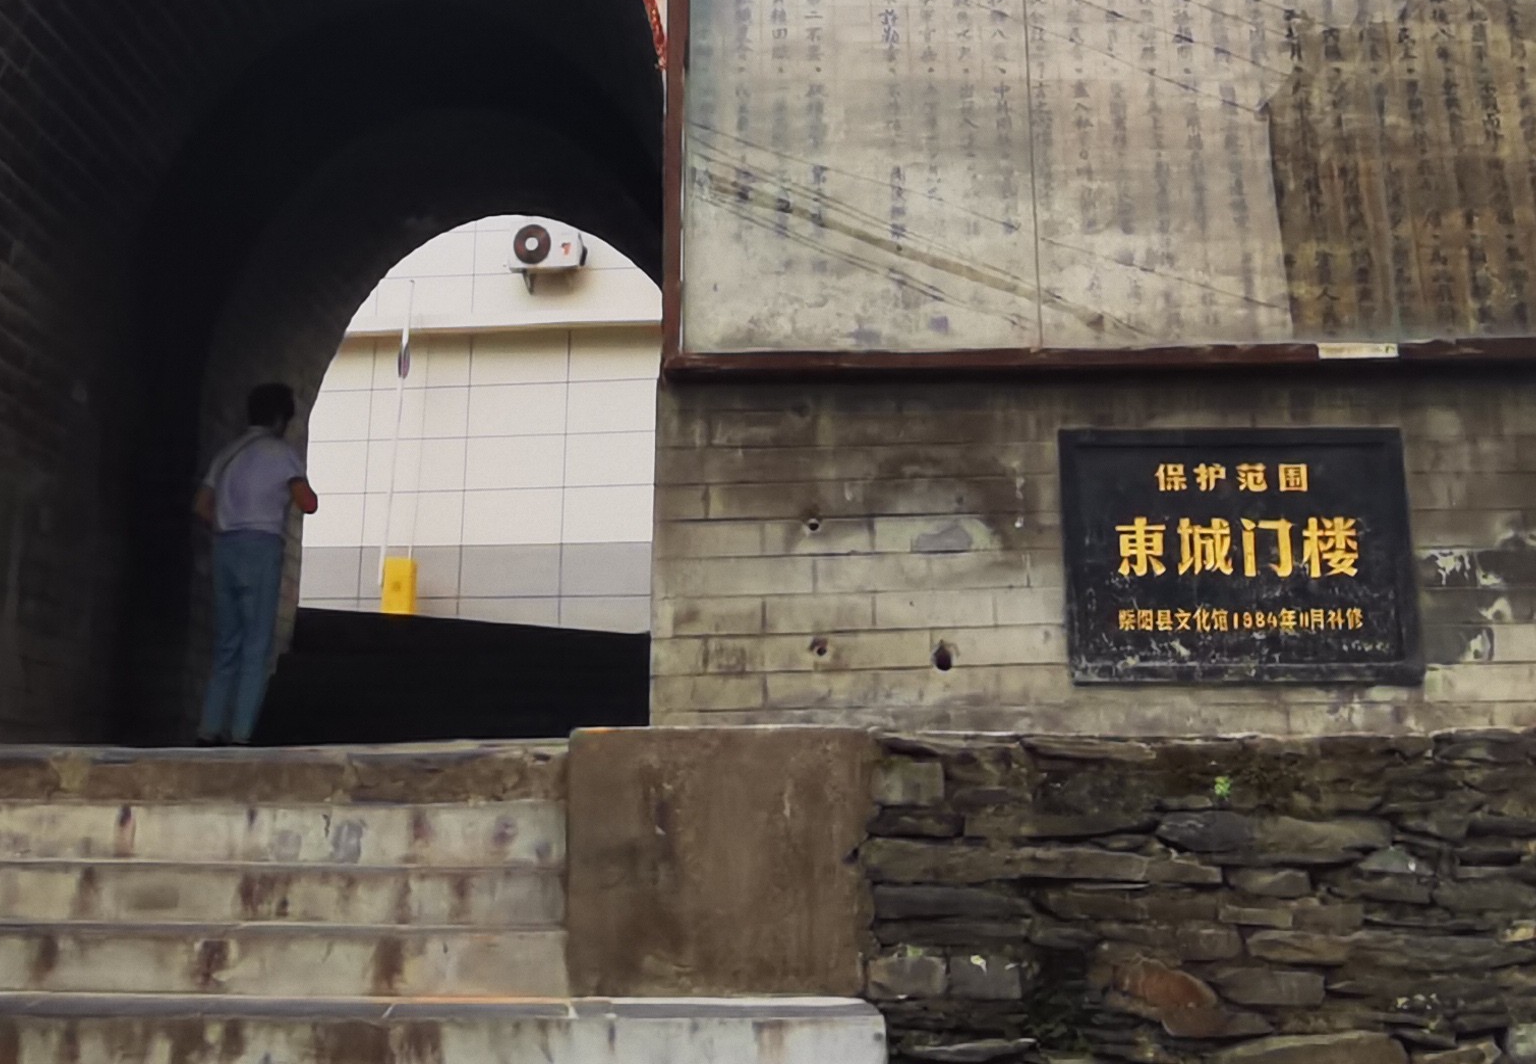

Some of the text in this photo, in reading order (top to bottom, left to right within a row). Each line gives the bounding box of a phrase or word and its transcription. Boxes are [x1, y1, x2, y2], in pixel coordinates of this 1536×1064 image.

[1155, 462, 1310, 493] 保护范围
[1114, 516, 1360, 578] 東城门楼
